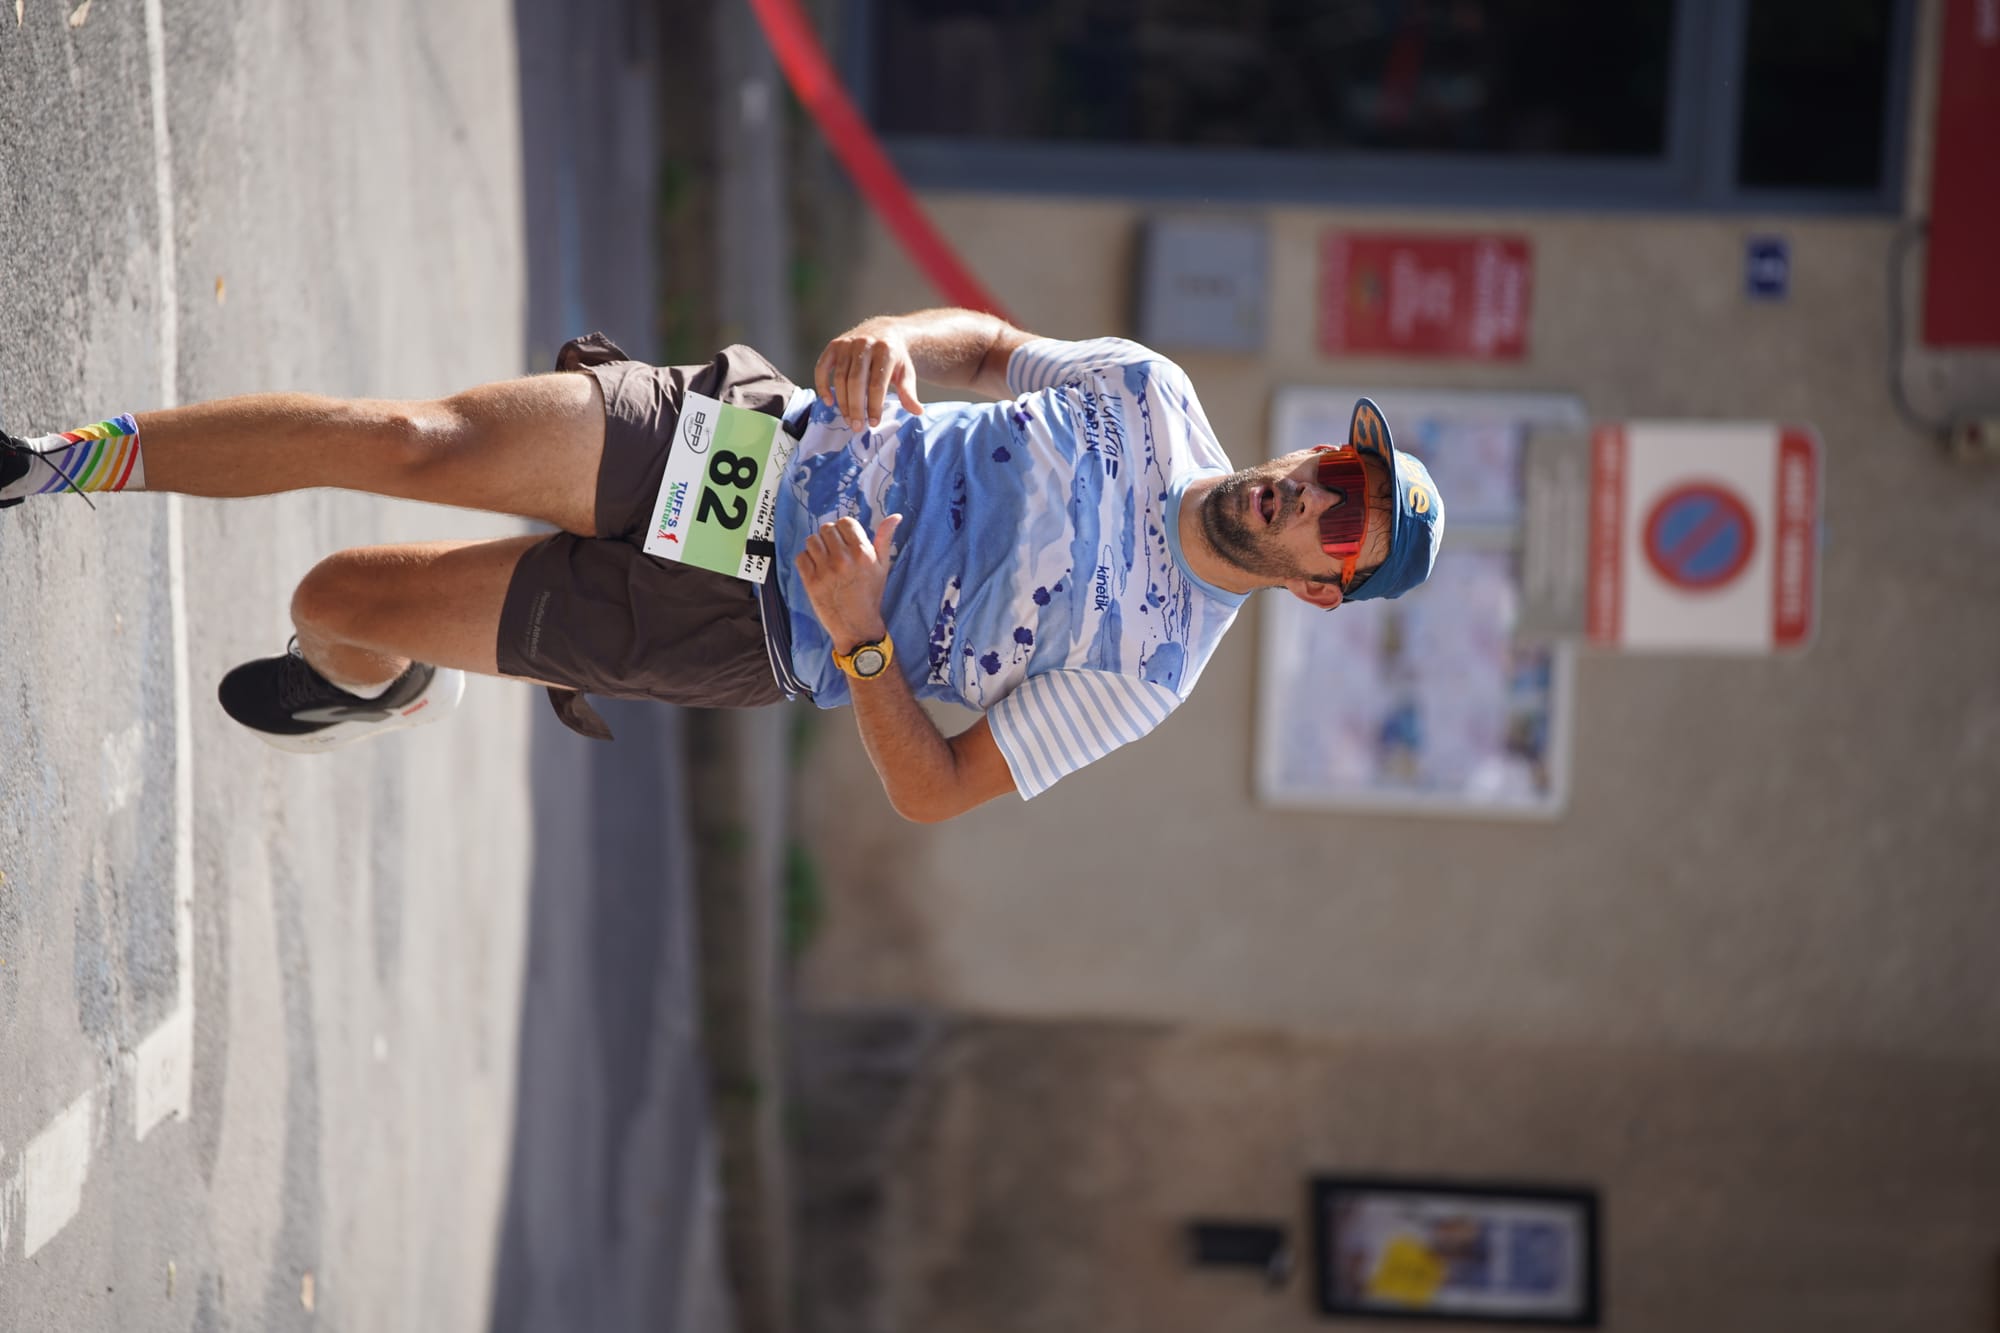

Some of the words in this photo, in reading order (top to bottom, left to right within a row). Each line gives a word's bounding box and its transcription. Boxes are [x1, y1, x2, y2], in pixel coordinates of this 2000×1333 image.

[691, 412, 706, 447] BFP
[660, 482, 680, 530] Aventure
[668, 482, 688, 528] TUFF'S
[696, 450, 758, 530] 82
[757, 490, 771, 524] vallées
[1094, 566, 1110, 612] kinetik
